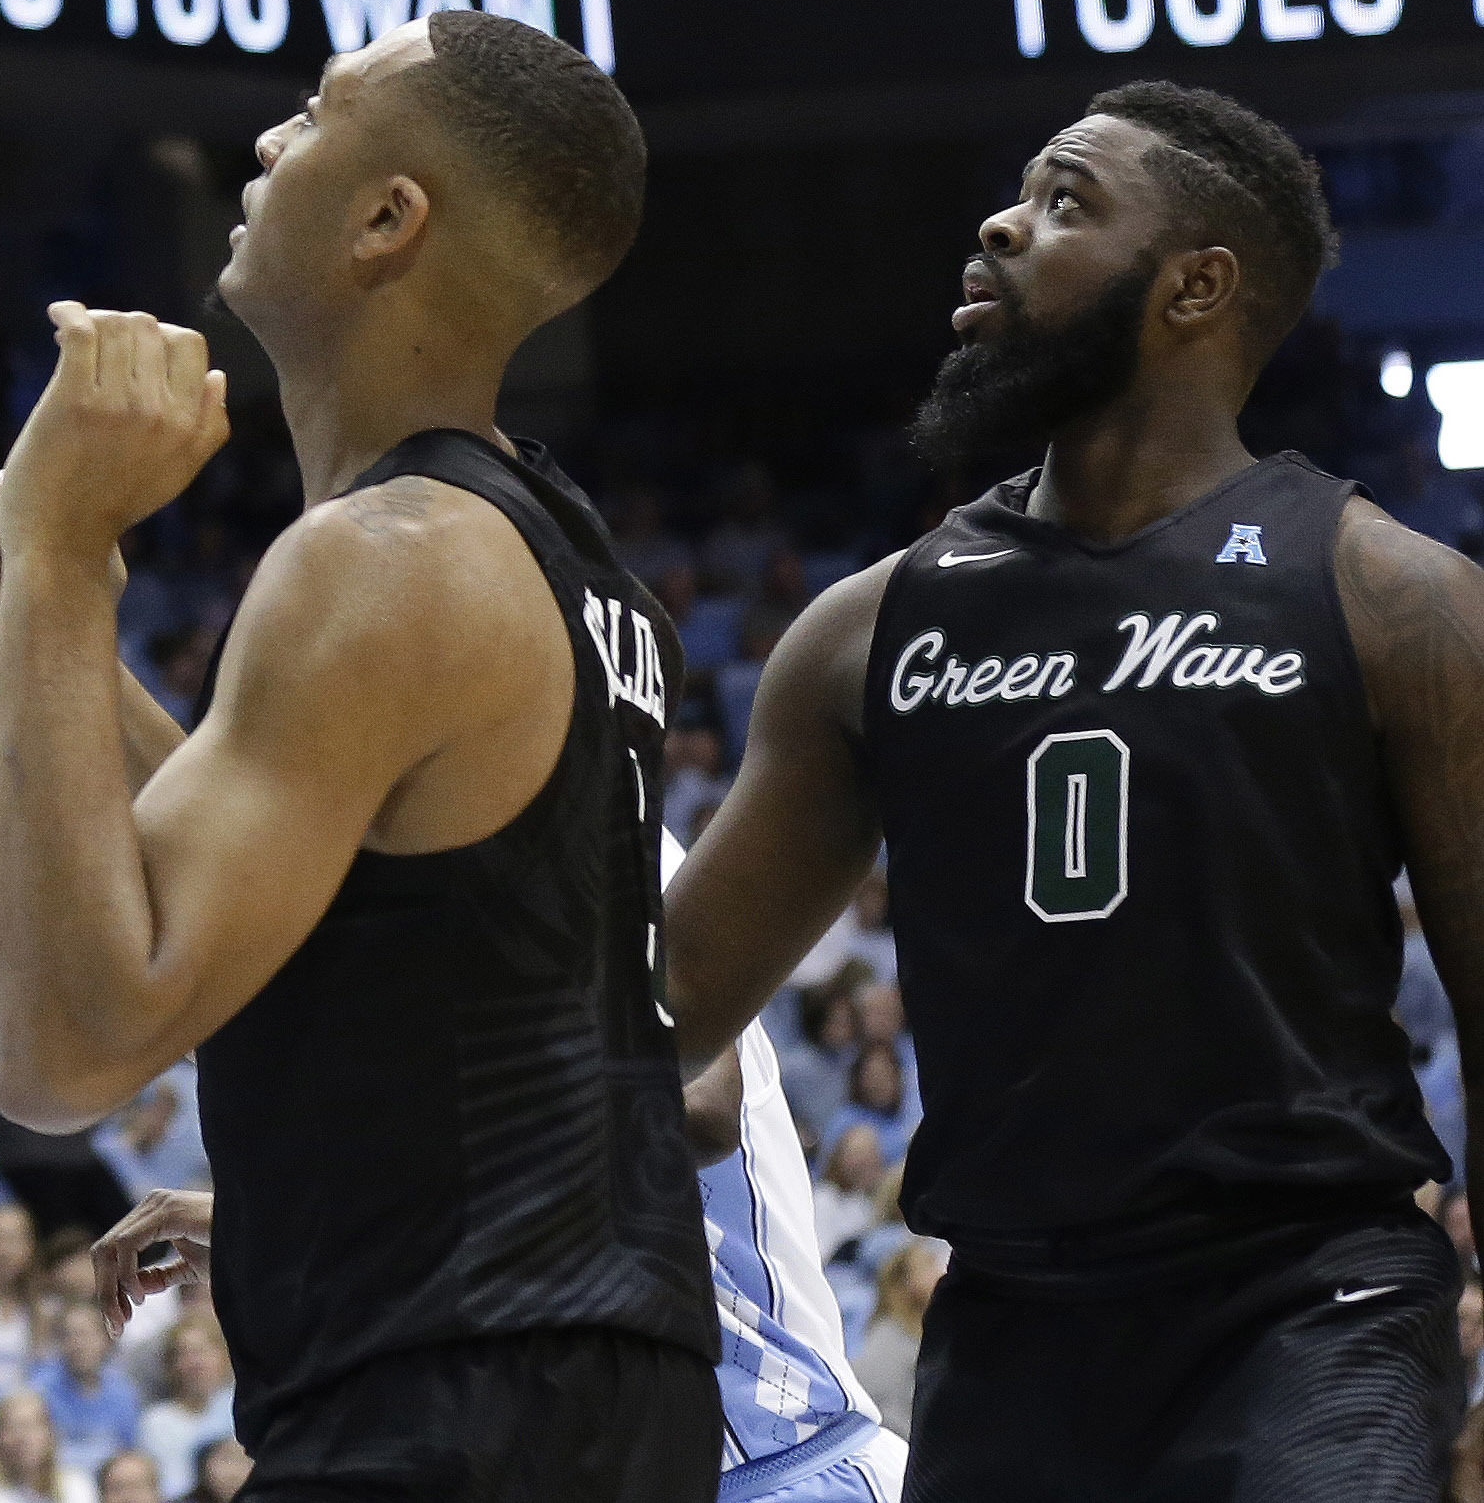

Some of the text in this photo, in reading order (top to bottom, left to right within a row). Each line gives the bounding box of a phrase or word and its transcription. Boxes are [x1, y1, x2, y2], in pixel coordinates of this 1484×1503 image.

[889, 611, 1308, 715] Green Wave
[1024, 729, 1130, 923] 0
